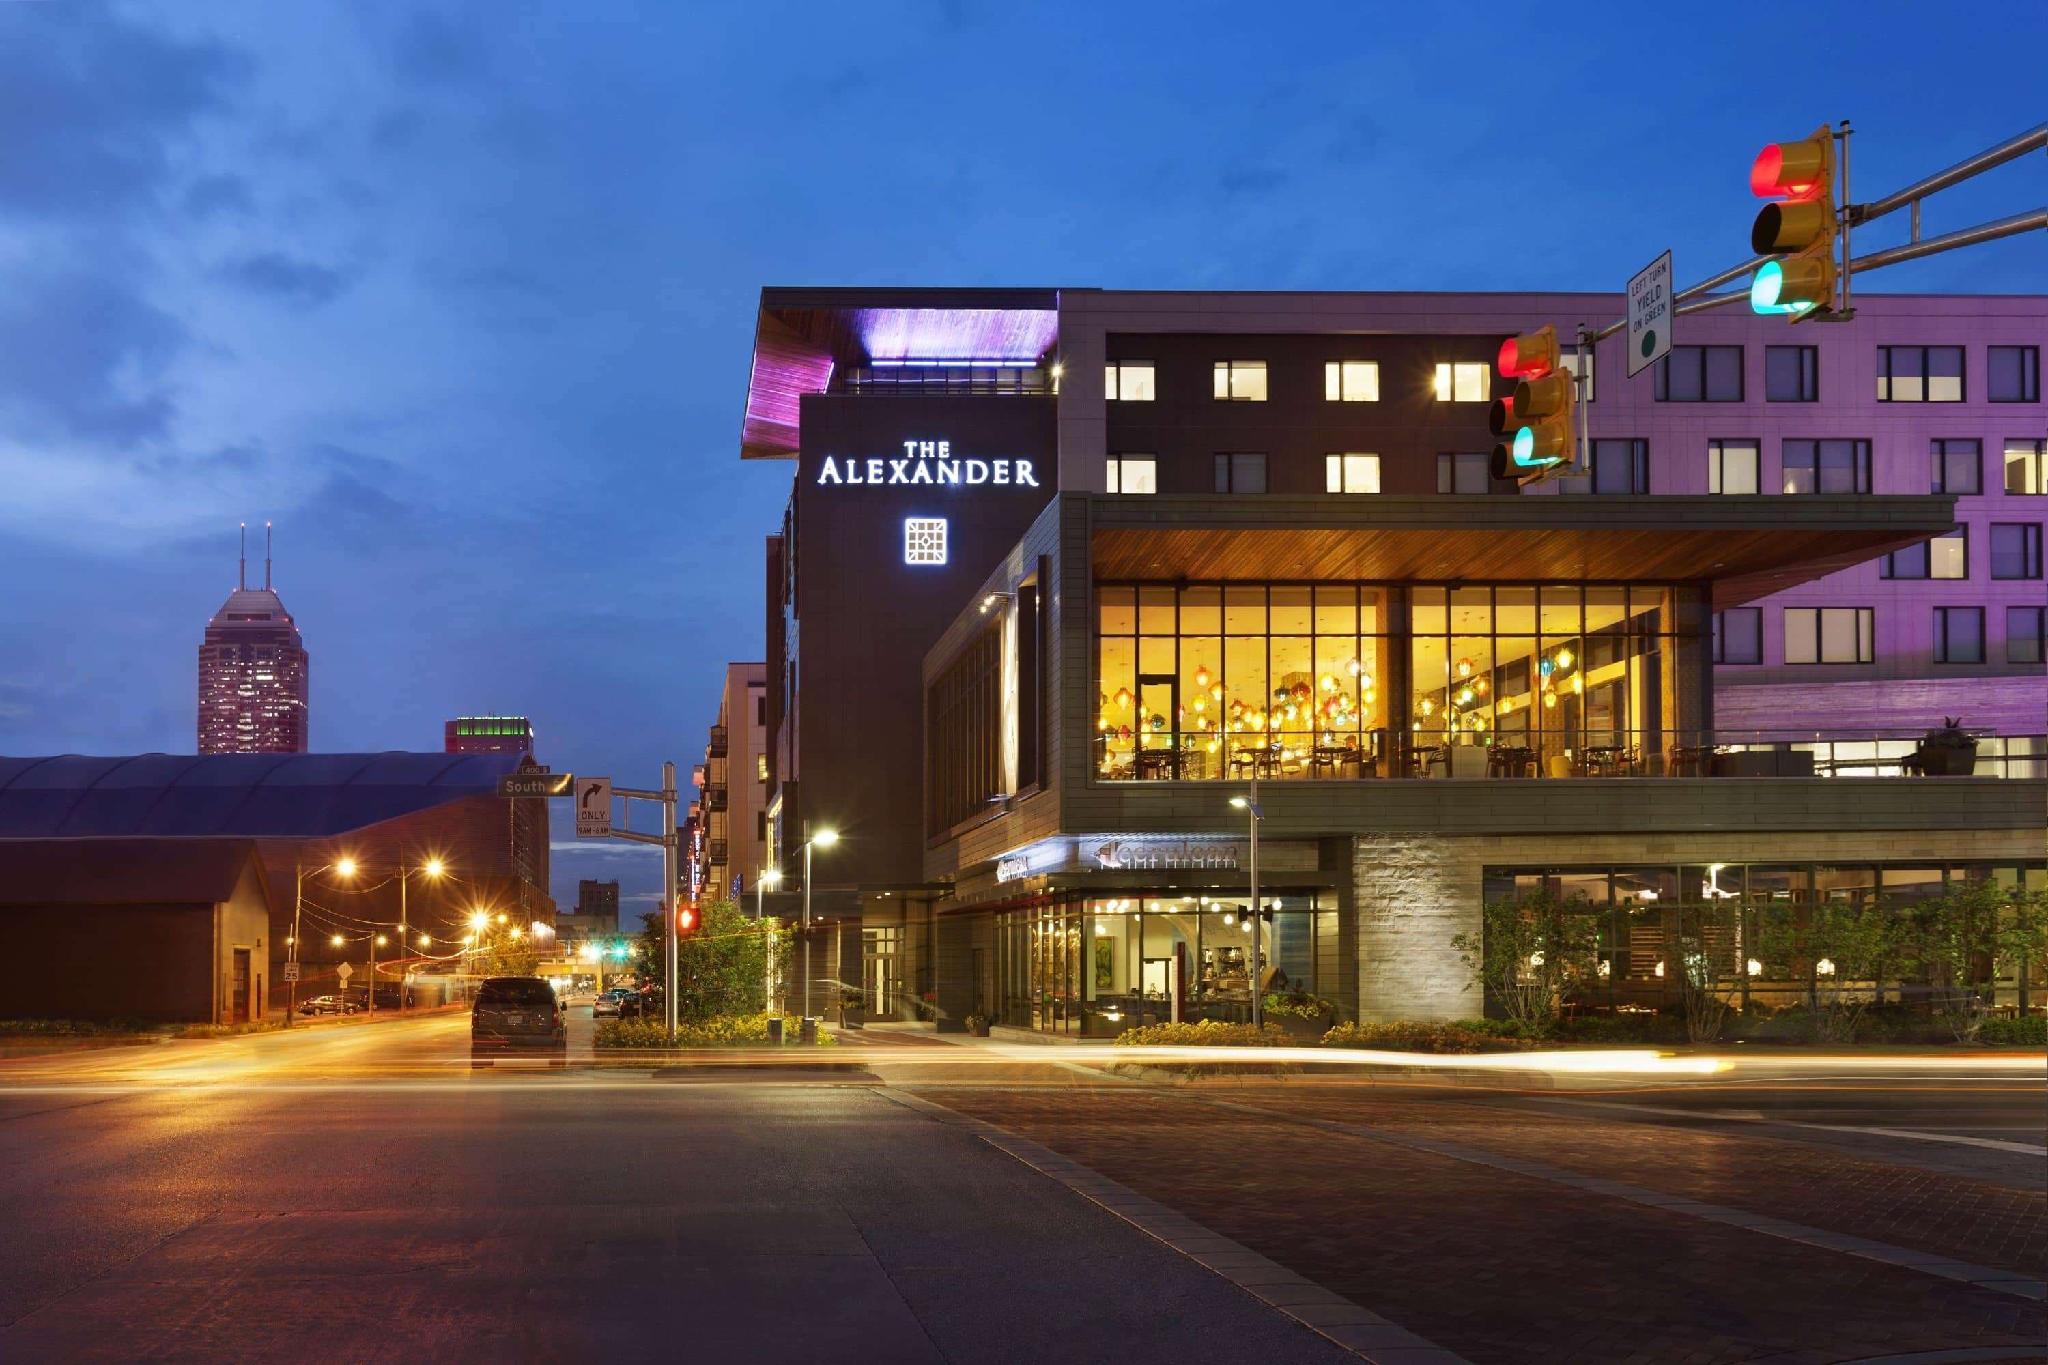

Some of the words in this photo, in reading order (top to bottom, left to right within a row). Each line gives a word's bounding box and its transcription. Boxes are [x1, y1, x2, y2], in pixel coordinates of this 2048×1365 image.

[1631, 276, 1647, 297] LEFT
[1649, 261, 1666, 284] TURN
[1636, 284, 1662, 312] YIELD
[1633, 318, 1643, 334] ON
[1644, 302, 1667, 326] GREEN
[904, 441, 950, 458] THE
[506, 780, 545, 793] South
[581, 811, 606, 820] ONLY
[285, 972, 298, 980] 25
